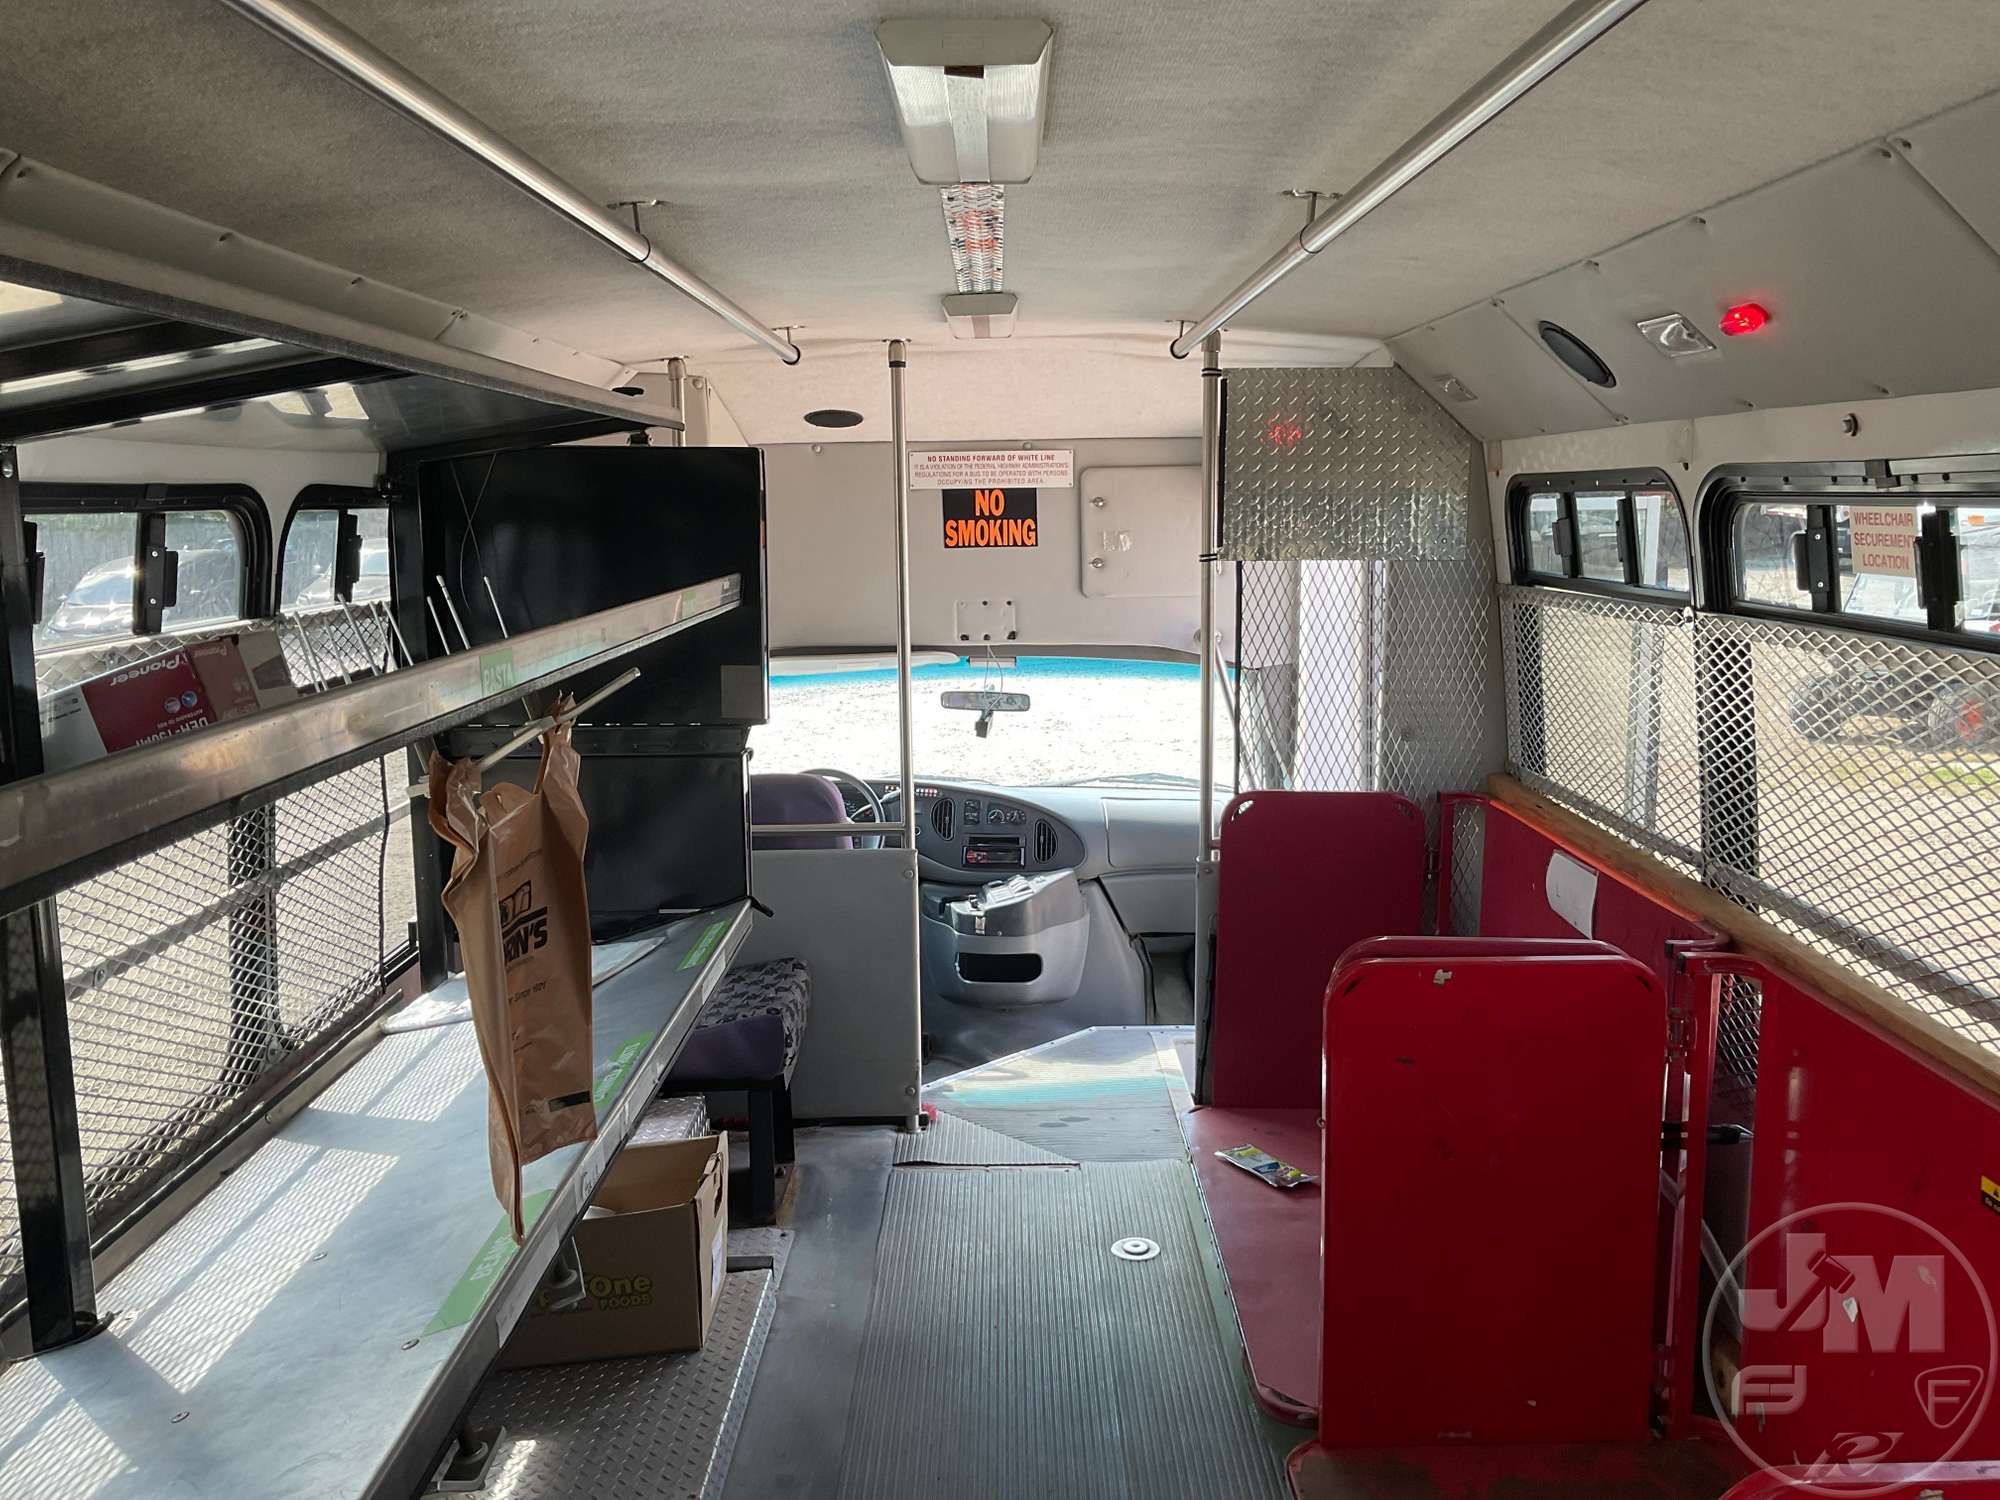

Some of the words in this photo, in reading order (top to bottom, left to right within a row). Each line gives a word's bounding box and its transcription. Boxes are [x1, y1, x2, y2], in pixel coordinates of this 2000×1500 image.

[938, 455, 971, 463] STANDING
[974, 489, 1005, 517] NO
[1853, 511, 1914, 527] WHEELCHAIR
[944, 518, 1037, 547] SMOKING
[1854, 532, 1916, 548] SECUREMENT
[1862, 553, 1910, 570] LOCATION
[110, 654, 180, 687] Pioneer
[483, 663, 515, 696] PASTA
